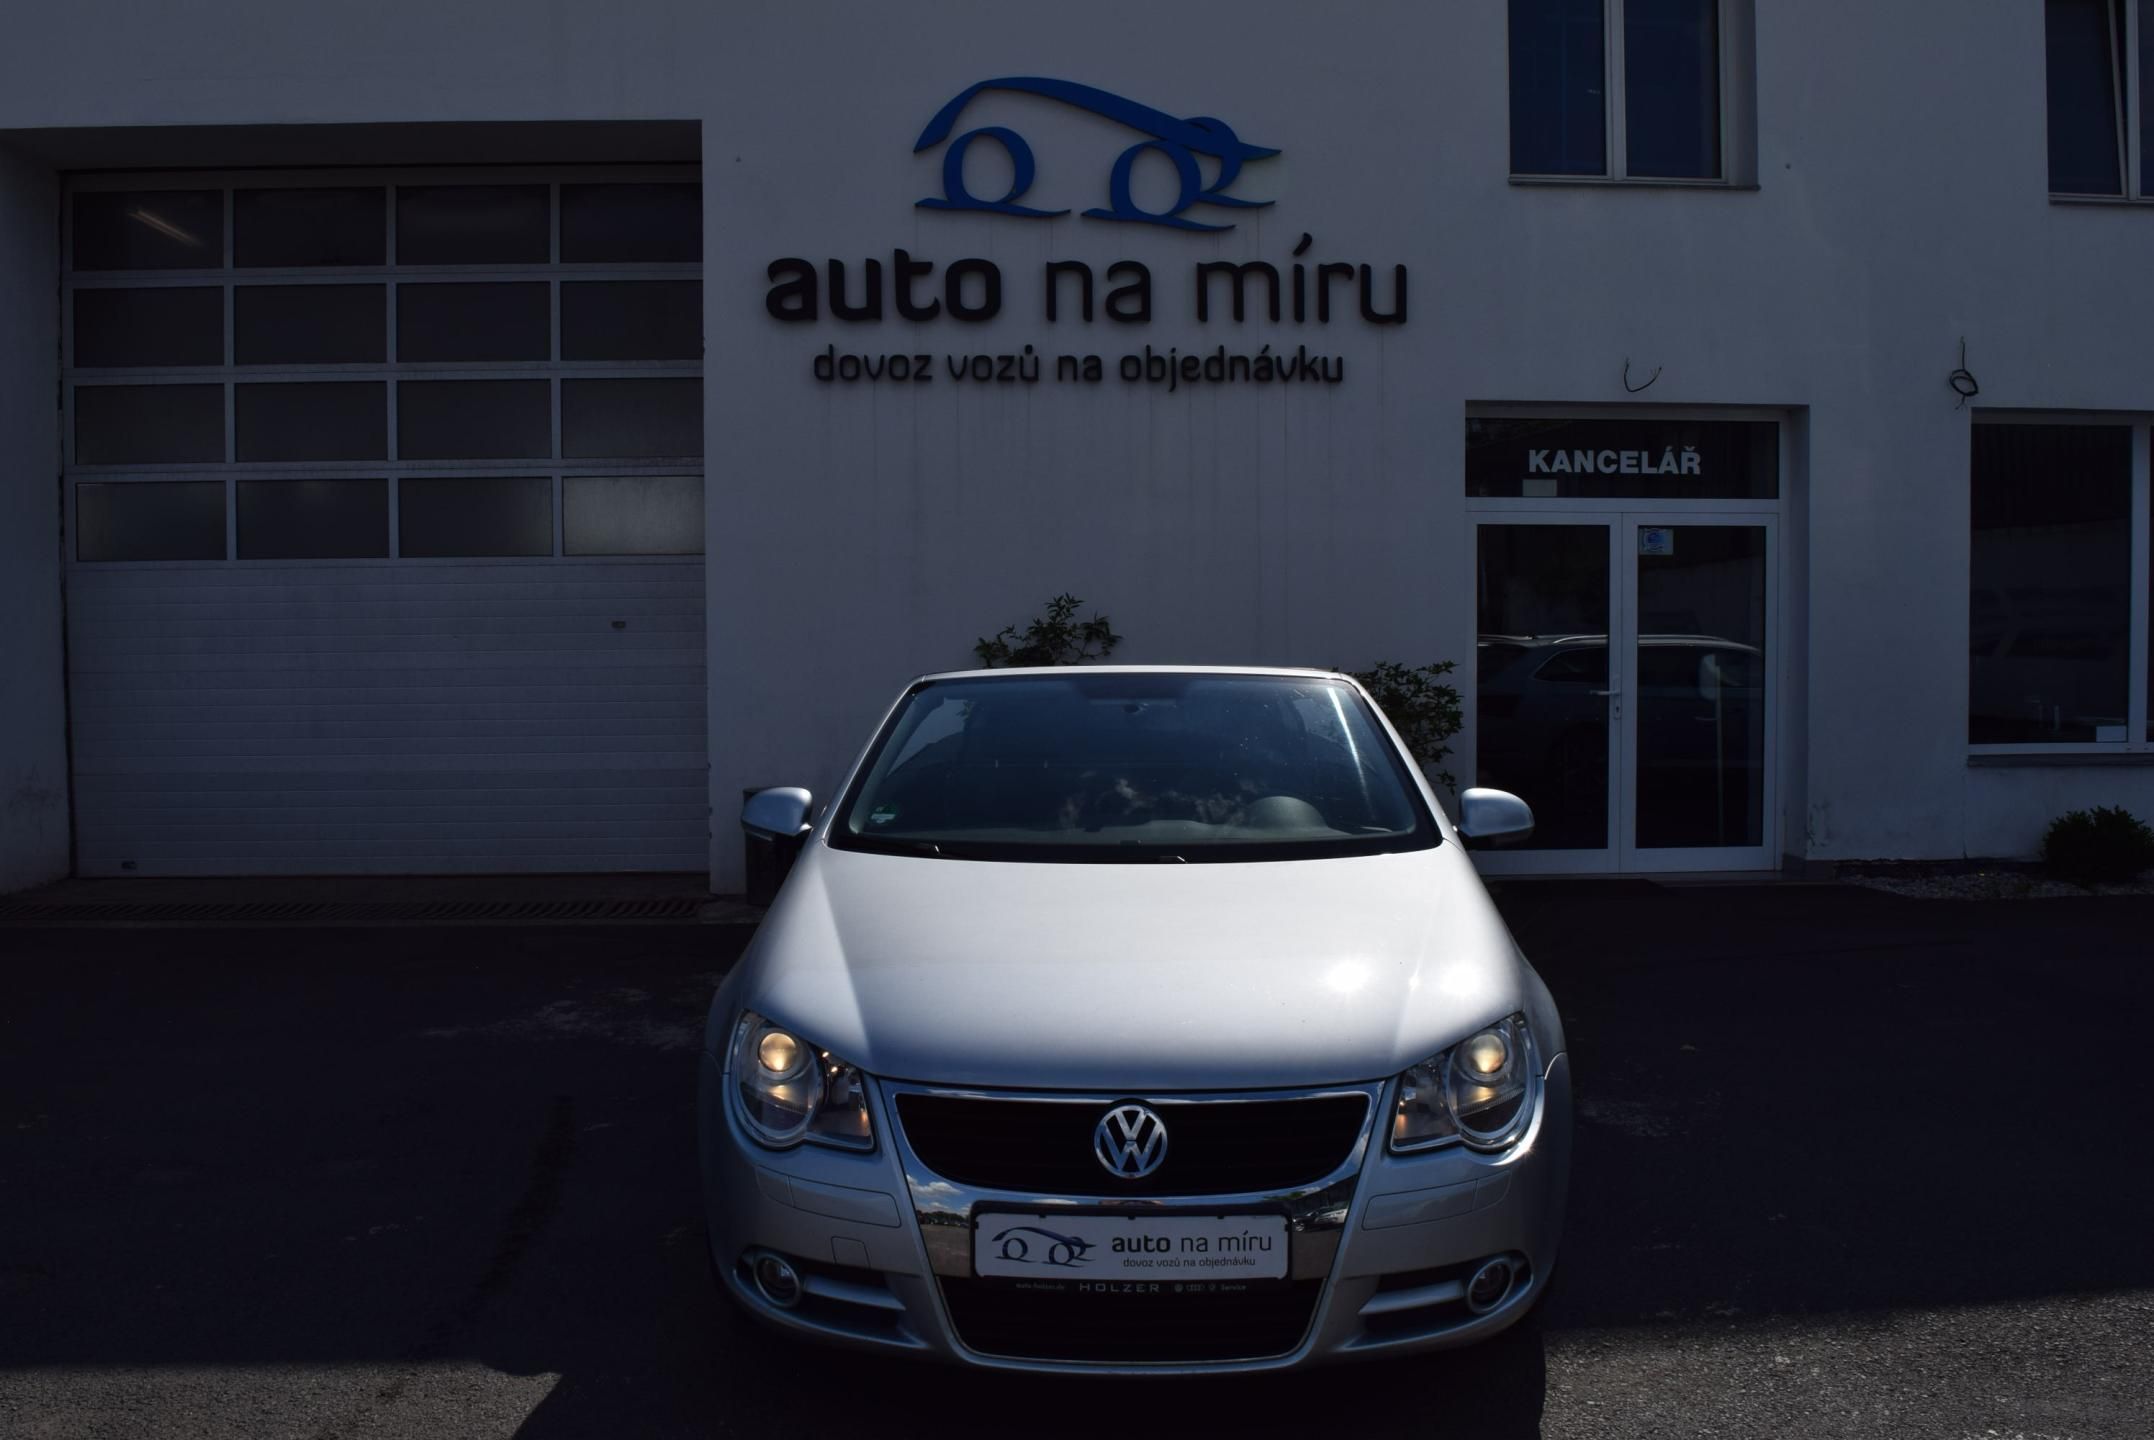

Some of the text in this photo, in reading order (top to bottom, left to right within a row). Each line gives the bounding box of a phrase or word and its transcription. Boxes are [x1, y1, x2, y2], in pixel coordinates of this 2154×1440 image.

[766, 233, 1408, 324] auto na míru
[813, 344, 1344, 392] dovoz vozů na objednávku
[1528, 446, 1701, 475] KANCELÁŘ
[1111, 1230, 1272, 1253] auto na míru
[1123, 1256, 1256, 1269] dovoz vozů na objednávku
[1079, 1283, 1160, 1292] HOLZER
